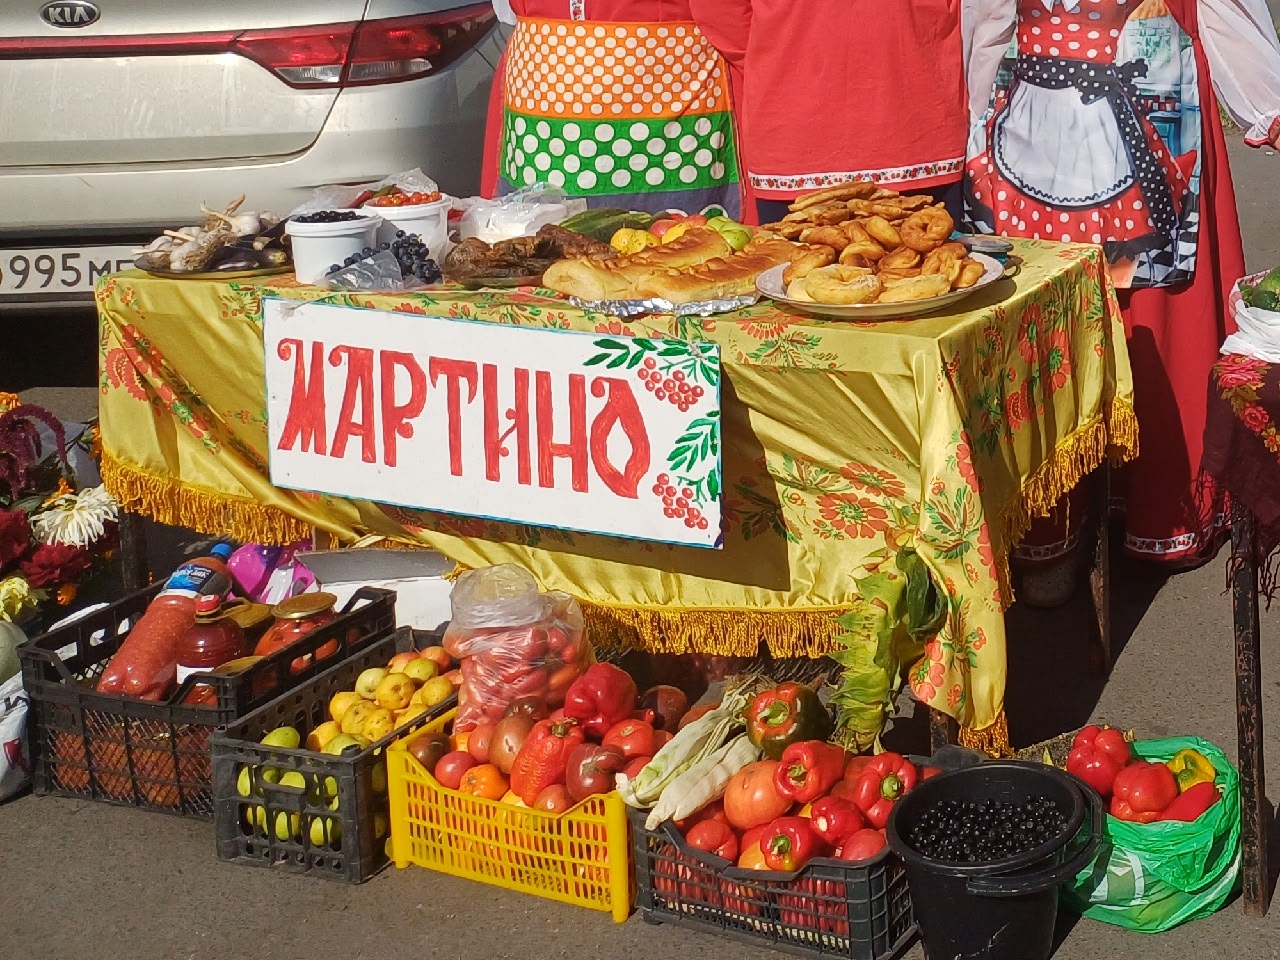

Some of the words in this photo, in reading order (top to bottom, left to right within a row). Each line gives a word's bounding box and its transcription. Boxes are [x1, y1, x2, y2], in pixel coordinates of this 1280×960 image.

[48, 6, 91, 23] KIA
[0, 252, 134, 289] 995М
[277, 337, 651, 499] МАРТИНО
